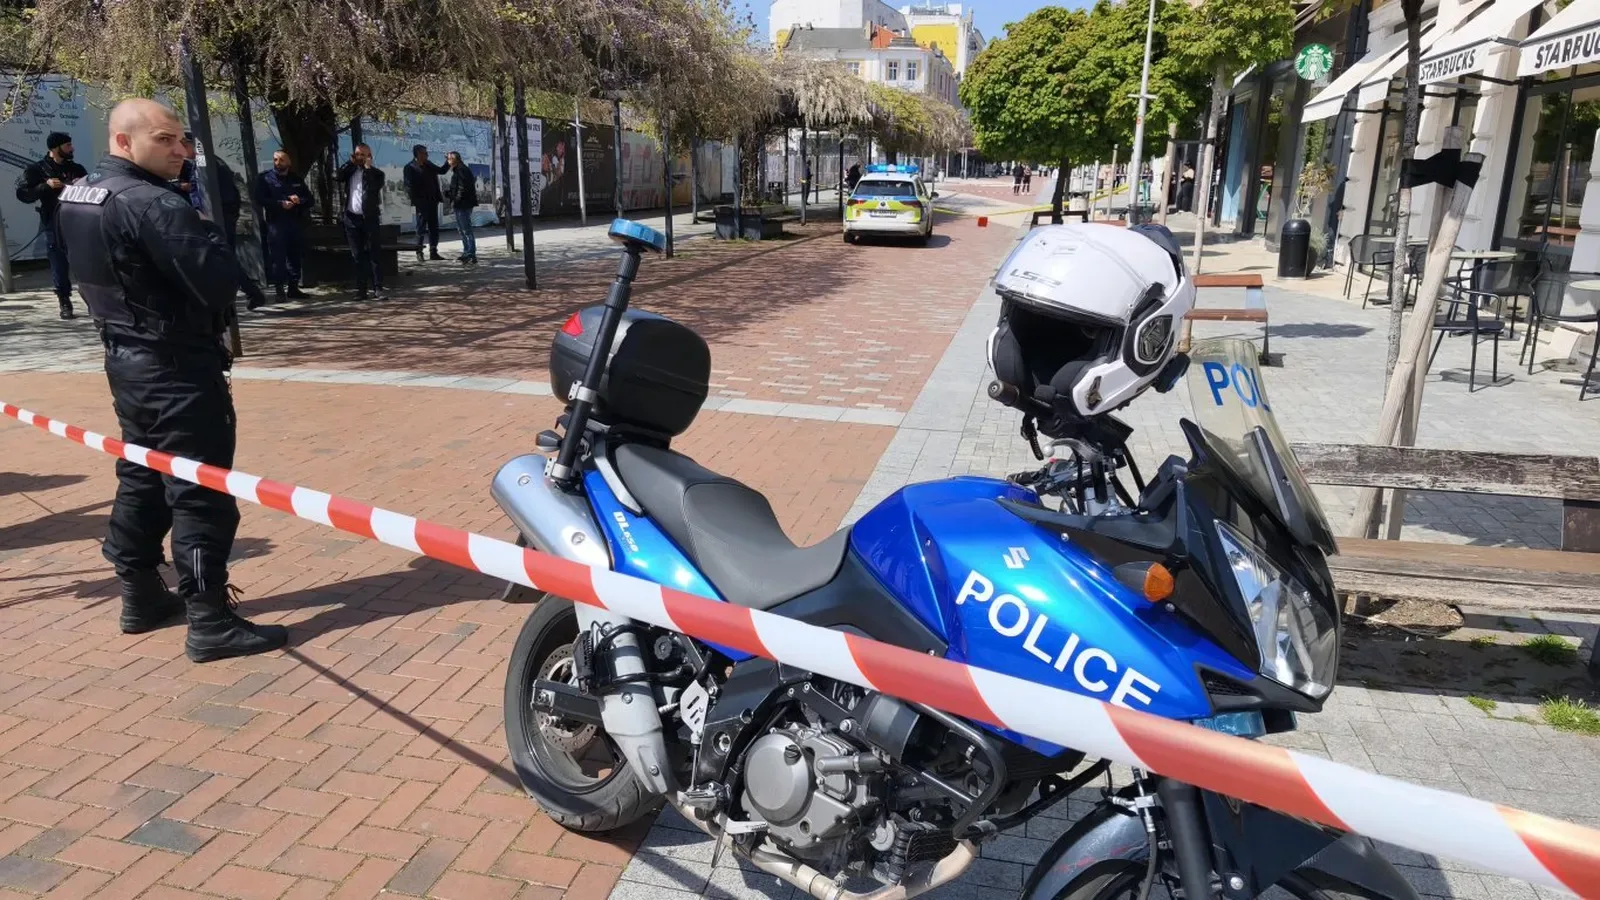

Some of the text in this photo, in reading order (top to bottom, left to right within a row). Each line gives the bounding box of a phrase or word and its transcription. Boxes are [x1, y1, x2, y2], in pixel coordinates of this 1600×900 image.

[1419, 50, 1476, 80] STARBUCKS
[58, 184, 108, 204] POLICE
[955, 569, 1161, 711] POLICE
